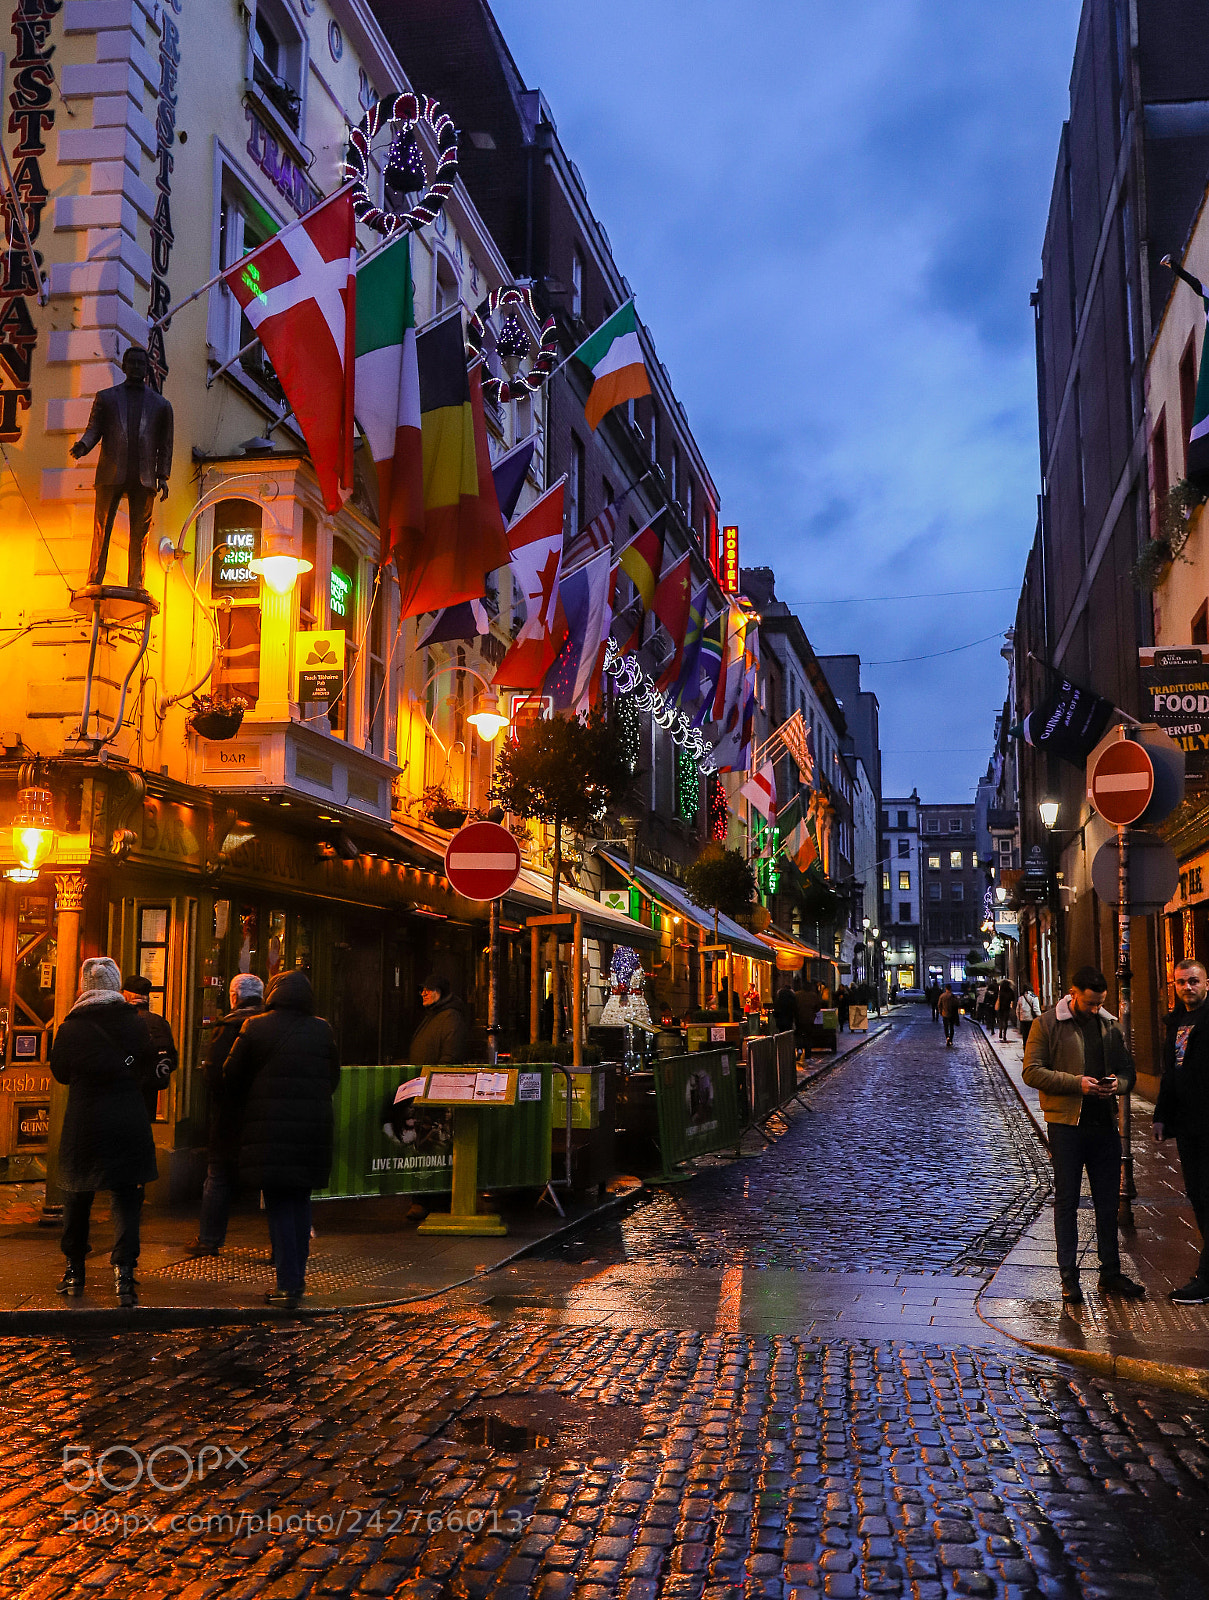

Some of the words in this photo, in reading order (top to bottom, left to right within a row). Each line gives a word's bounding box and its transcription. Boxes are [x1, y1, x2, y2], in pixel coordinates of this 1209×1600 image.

[0, 0, 58, 441] ESTAURANT
[226, 534, 254, 547] LIVE
[726, 528, 737, 590] HOSTEL
[1148, 681, 1209, 696] TRADITIONA
[1154, 694, 1209, 713] FOOD
[1179, 865, 1204, 901] THE
[20, 1121, 49, 1132] GUINN
[371, 1158, 392, 1172] LIVE
[392, 1155, 447, 1170] TRADITIONAL
